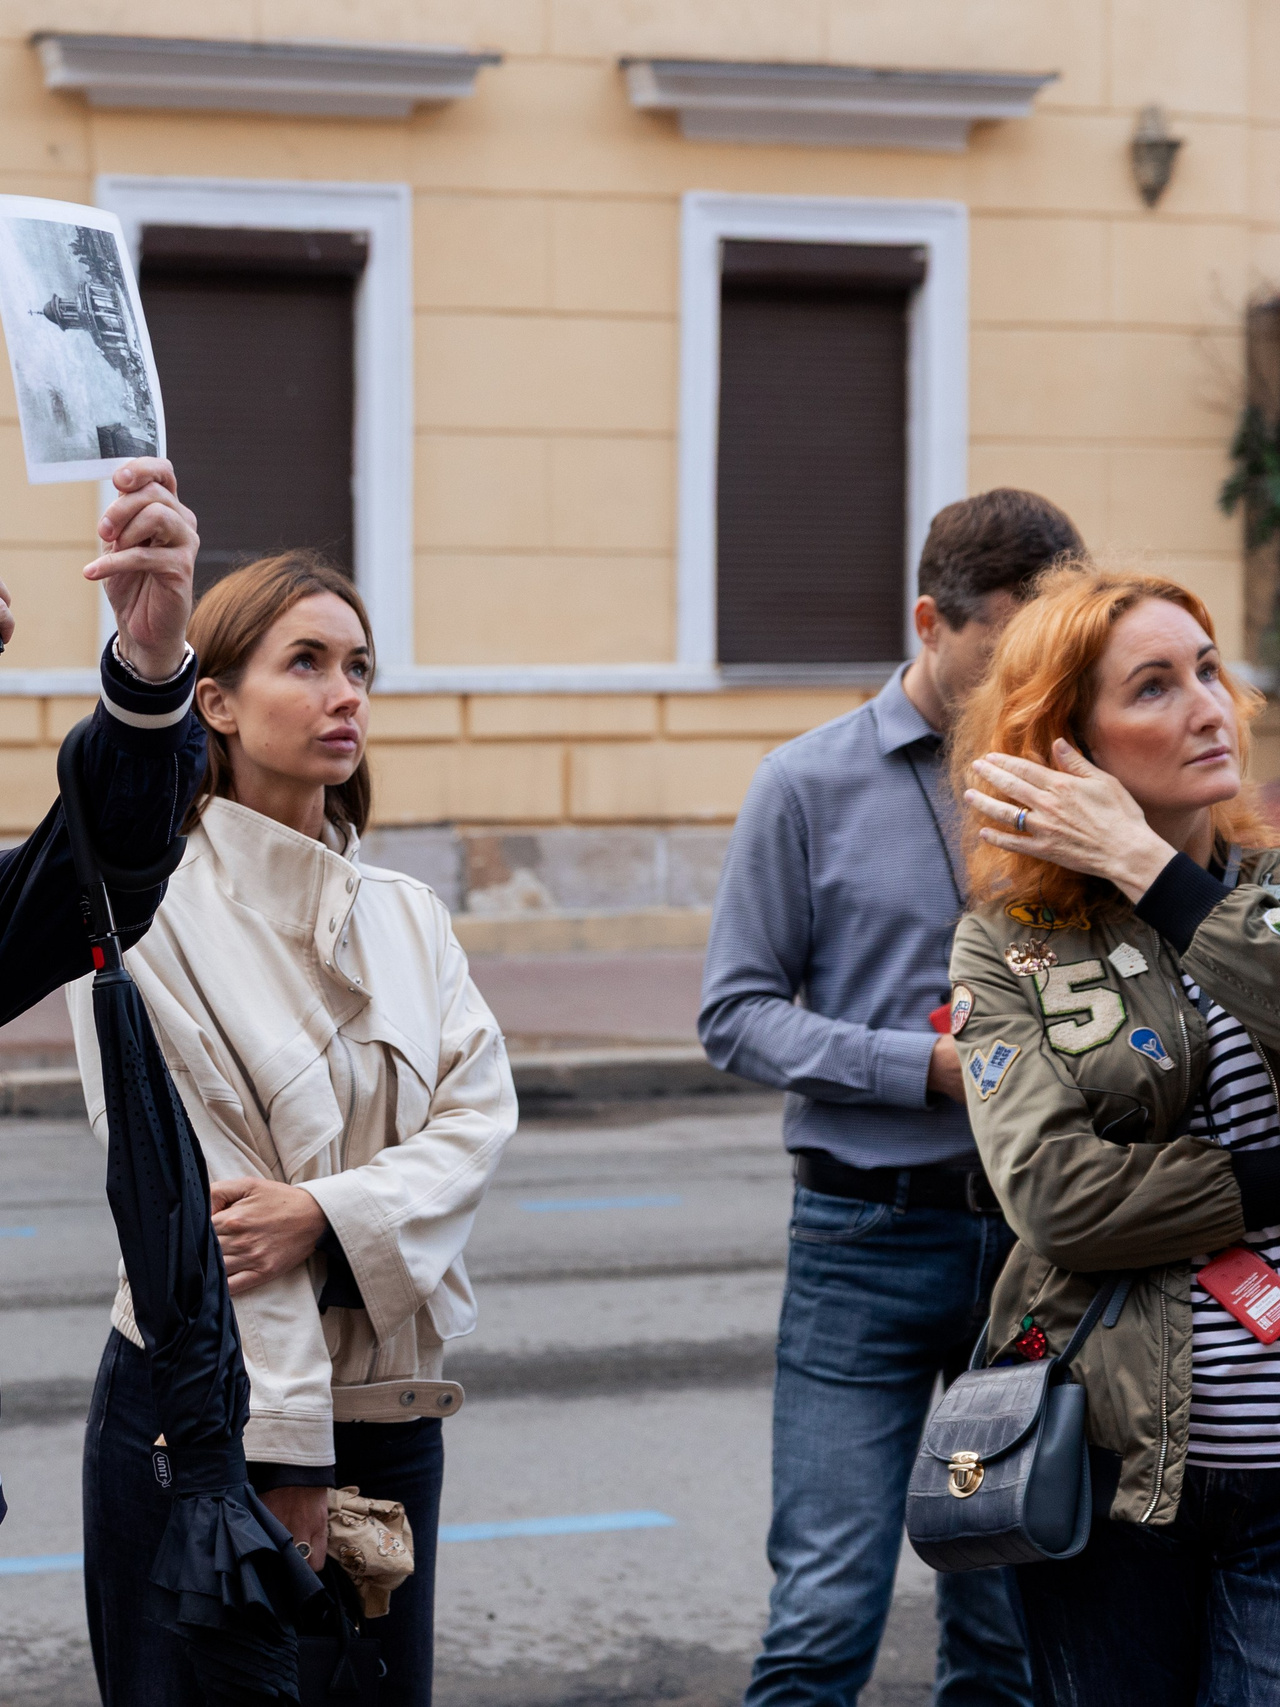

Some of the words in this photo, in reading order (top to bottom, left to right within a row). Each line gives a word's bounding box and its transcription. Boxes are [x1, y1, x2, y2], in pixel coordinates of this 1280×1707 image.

[1033, 958, 1127, 1056] 5
[990, 1045, 1005, 1065] FREE
[997, 1048, 1012, 1067] PASS
